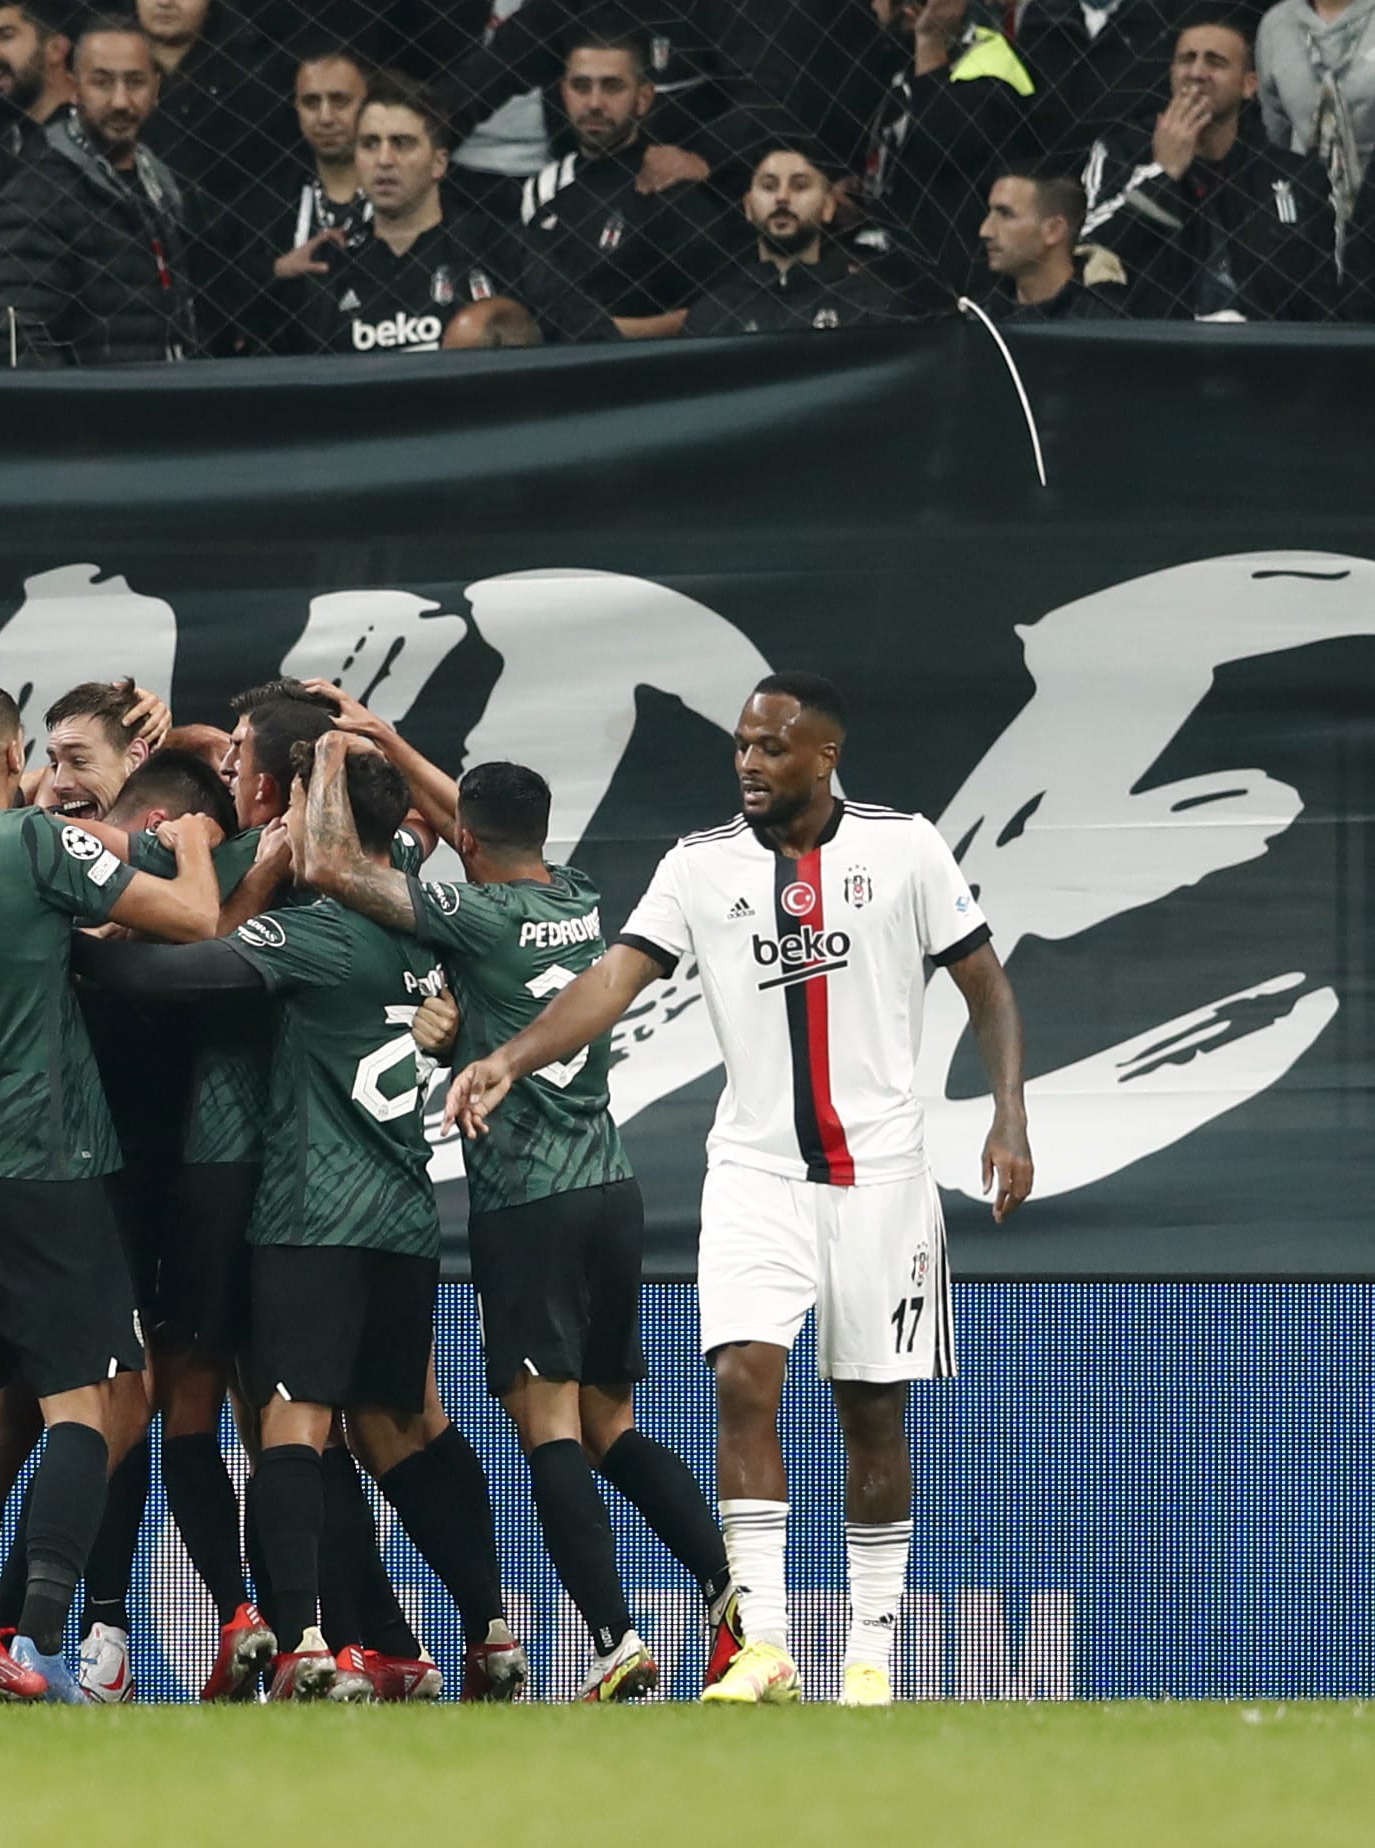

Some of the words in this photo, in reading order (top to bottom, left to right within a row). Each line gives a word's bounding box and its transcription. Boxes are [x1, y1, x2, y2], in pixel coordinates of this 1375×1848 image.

[352, 311, 442, 351] beko
[752, 925, 851, 966] beko
[891, 1296, 924, 1354] 17
